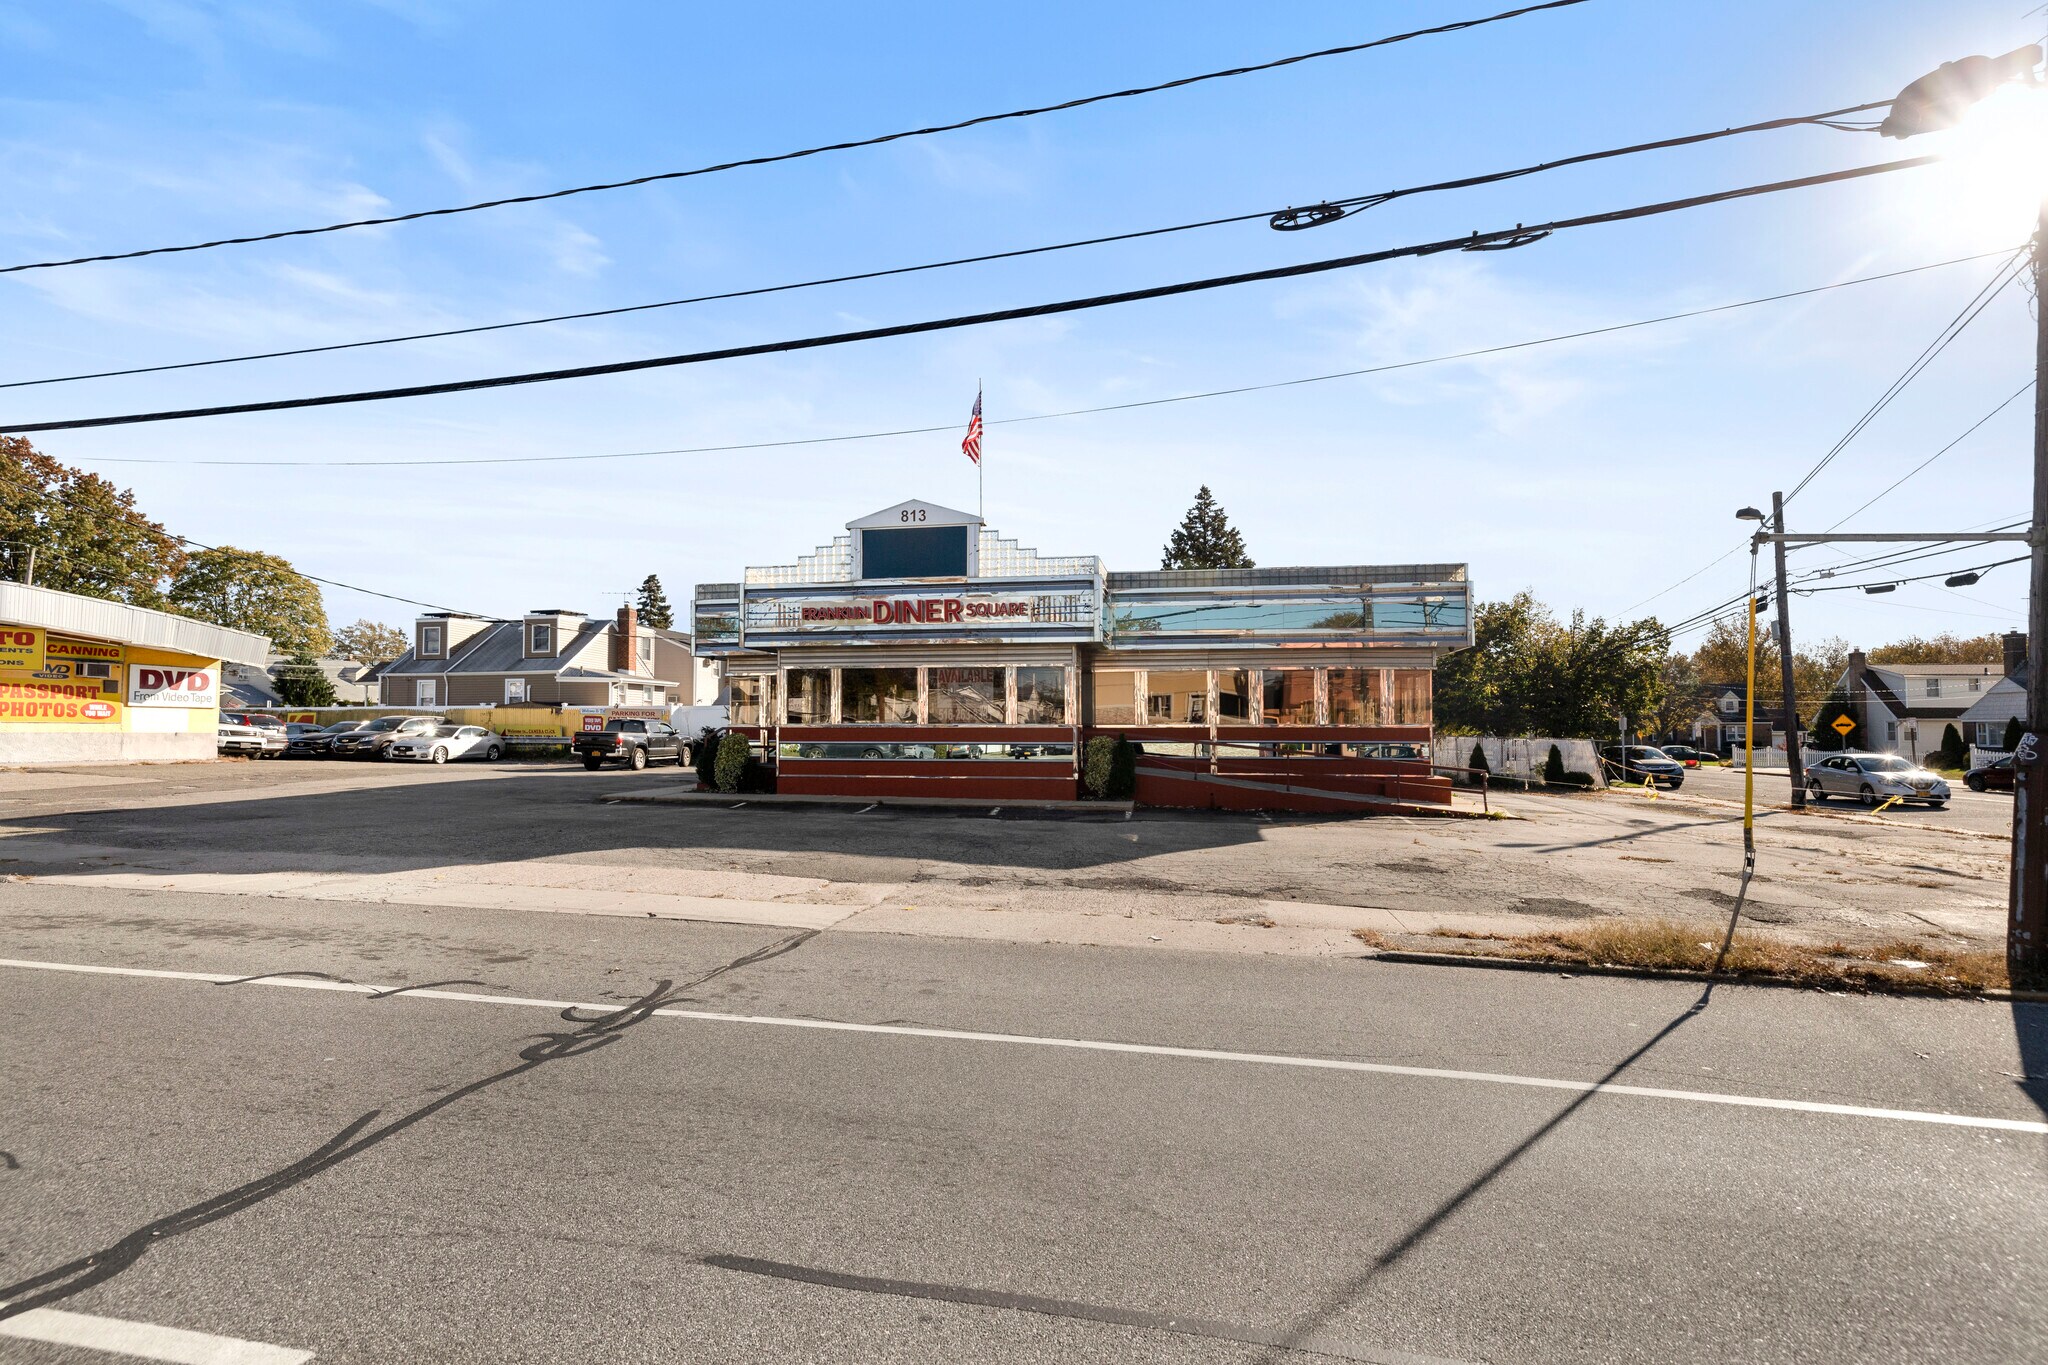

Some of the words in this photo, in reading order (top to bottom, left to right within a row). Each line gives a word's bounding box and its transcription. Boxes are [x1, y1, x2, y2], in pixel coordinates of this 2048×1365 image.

[901, 509, 927, 522] 813
[801, 606, 871, 621] FRANKLIN
[873, 598, 964, 624] DINER
[966, 602, 1030, 617] SQUARE
[46, 644, 120, 658] CANNING
[139, 669, 210, 691] DVD
[939, 669, 994, 683] AVAILABLE
[0, 683, 100, 700] PASSPORT
[133, 690, 160, 701] From
[162, 692, 190, 702] Video
[191, 693, 213, 705] Tape
[0, 702, 78, 717] PHOTOS
